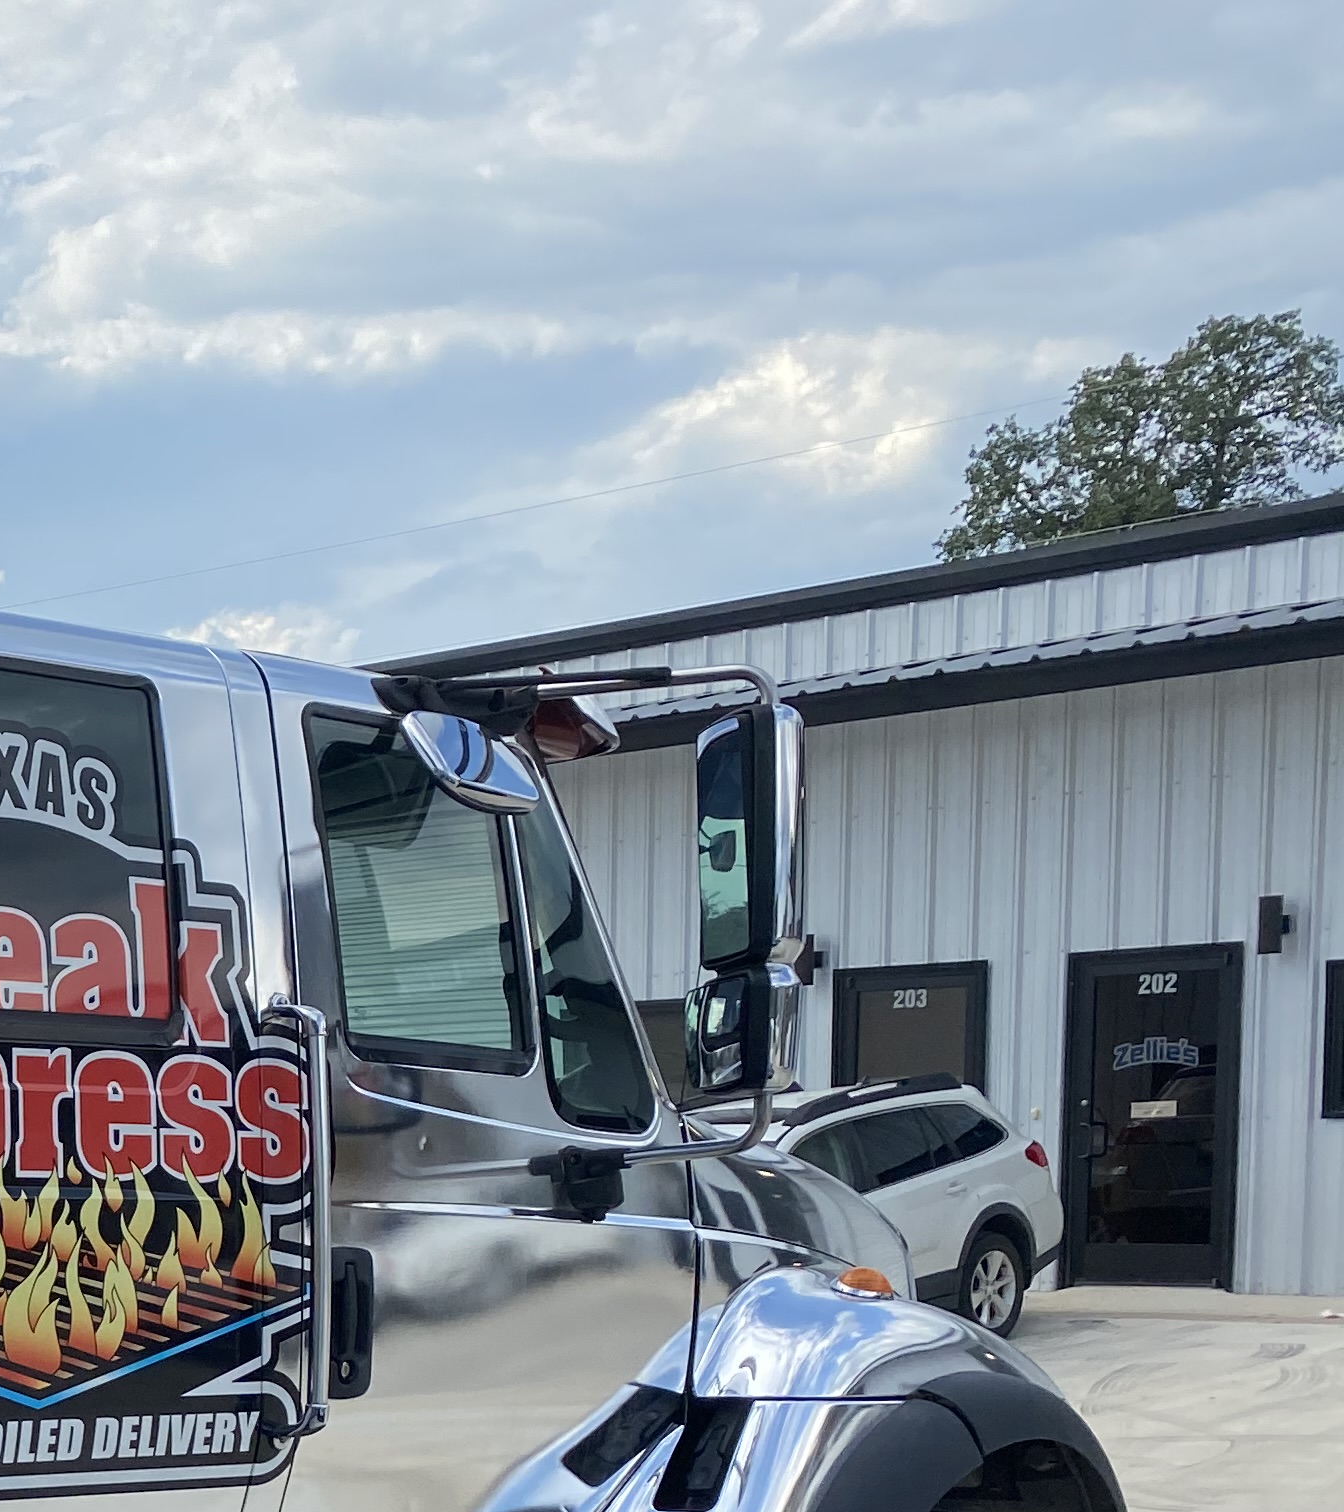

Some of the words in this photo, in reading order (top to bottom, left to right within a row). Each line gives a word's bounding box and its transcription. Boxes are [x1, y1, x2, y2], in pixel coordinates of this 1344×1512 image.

[1137, 972, 1178, 995] 202
[892, 988, 928, 1009] 203
[1113, 1036, 1199, 1071] Zellie's
[91, 1410, 261, 1461] DELIVERY
